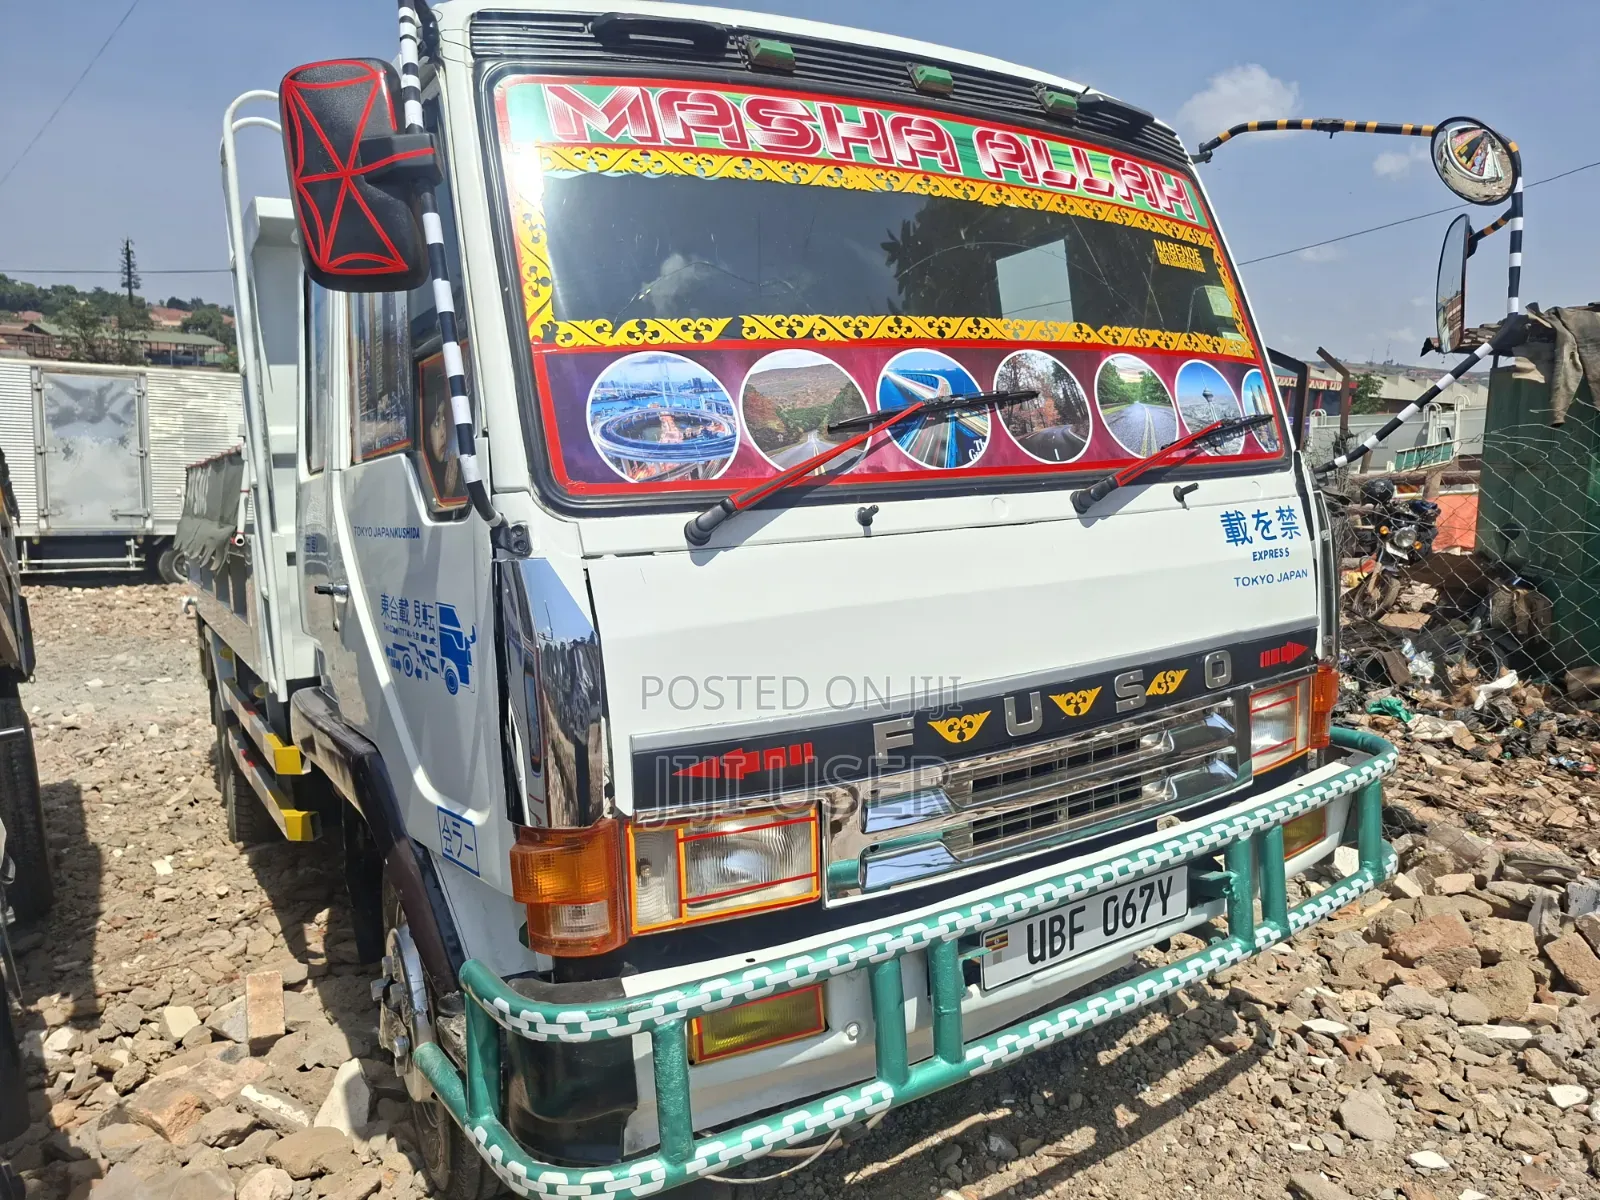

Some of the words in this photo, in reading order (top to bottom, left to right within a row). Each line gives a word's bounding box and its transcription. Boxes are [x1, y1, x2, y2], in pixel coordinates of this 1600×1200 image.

[542, 83, 962, 175] MASHA
[973, 126, 1199, 223] ALLAH
[1153, 239, 1202, 260] NABENDE
[1308, 379, 1328, 390] ANDA
[354, 526, 373, 537] TOKYO
[1219, 505, 1302, 546] 載を禁
[1252, 547, 1290, 561] EXPRESS
[1233, 573, 1275, 588] TOKYO
[1276, 568, 1308, 583] JAPAN
[1026, 905, 1086, 965] UBF
[1102, 875, 1173, 937] 067Y
